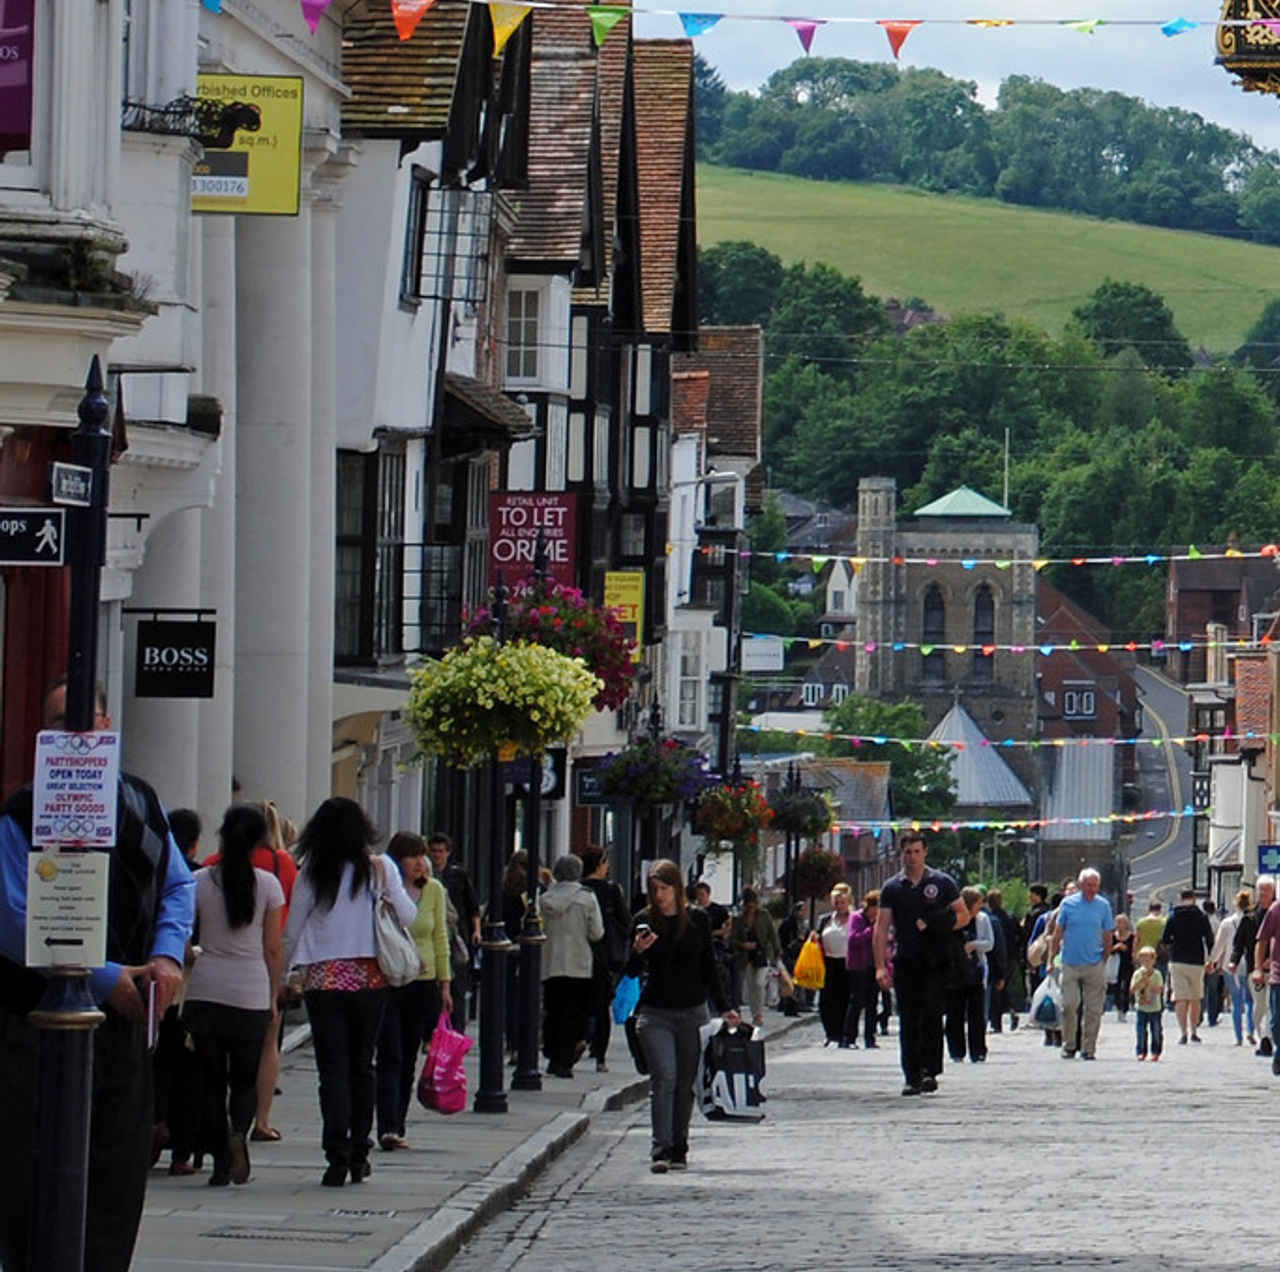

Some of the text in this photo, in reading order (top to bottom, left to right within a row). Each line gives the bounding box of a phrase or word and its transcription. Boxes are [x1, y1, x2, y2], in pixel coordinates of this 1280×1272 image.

[251, 84, 299, 99] Offices
[536, 497, 559, 506] UNIT
[498, 507, 568, 526] TO LET
[0, 519, 28, 536] ops
[501, 527, 516, 537] ALL
[144, 646, 208, 665] BOSS
[49, 769, 103, 779] OPEN TODAY
[55, 793, 94, 802] OLYMPIC
[44, 803, 105, 813] PARTY GOODS
